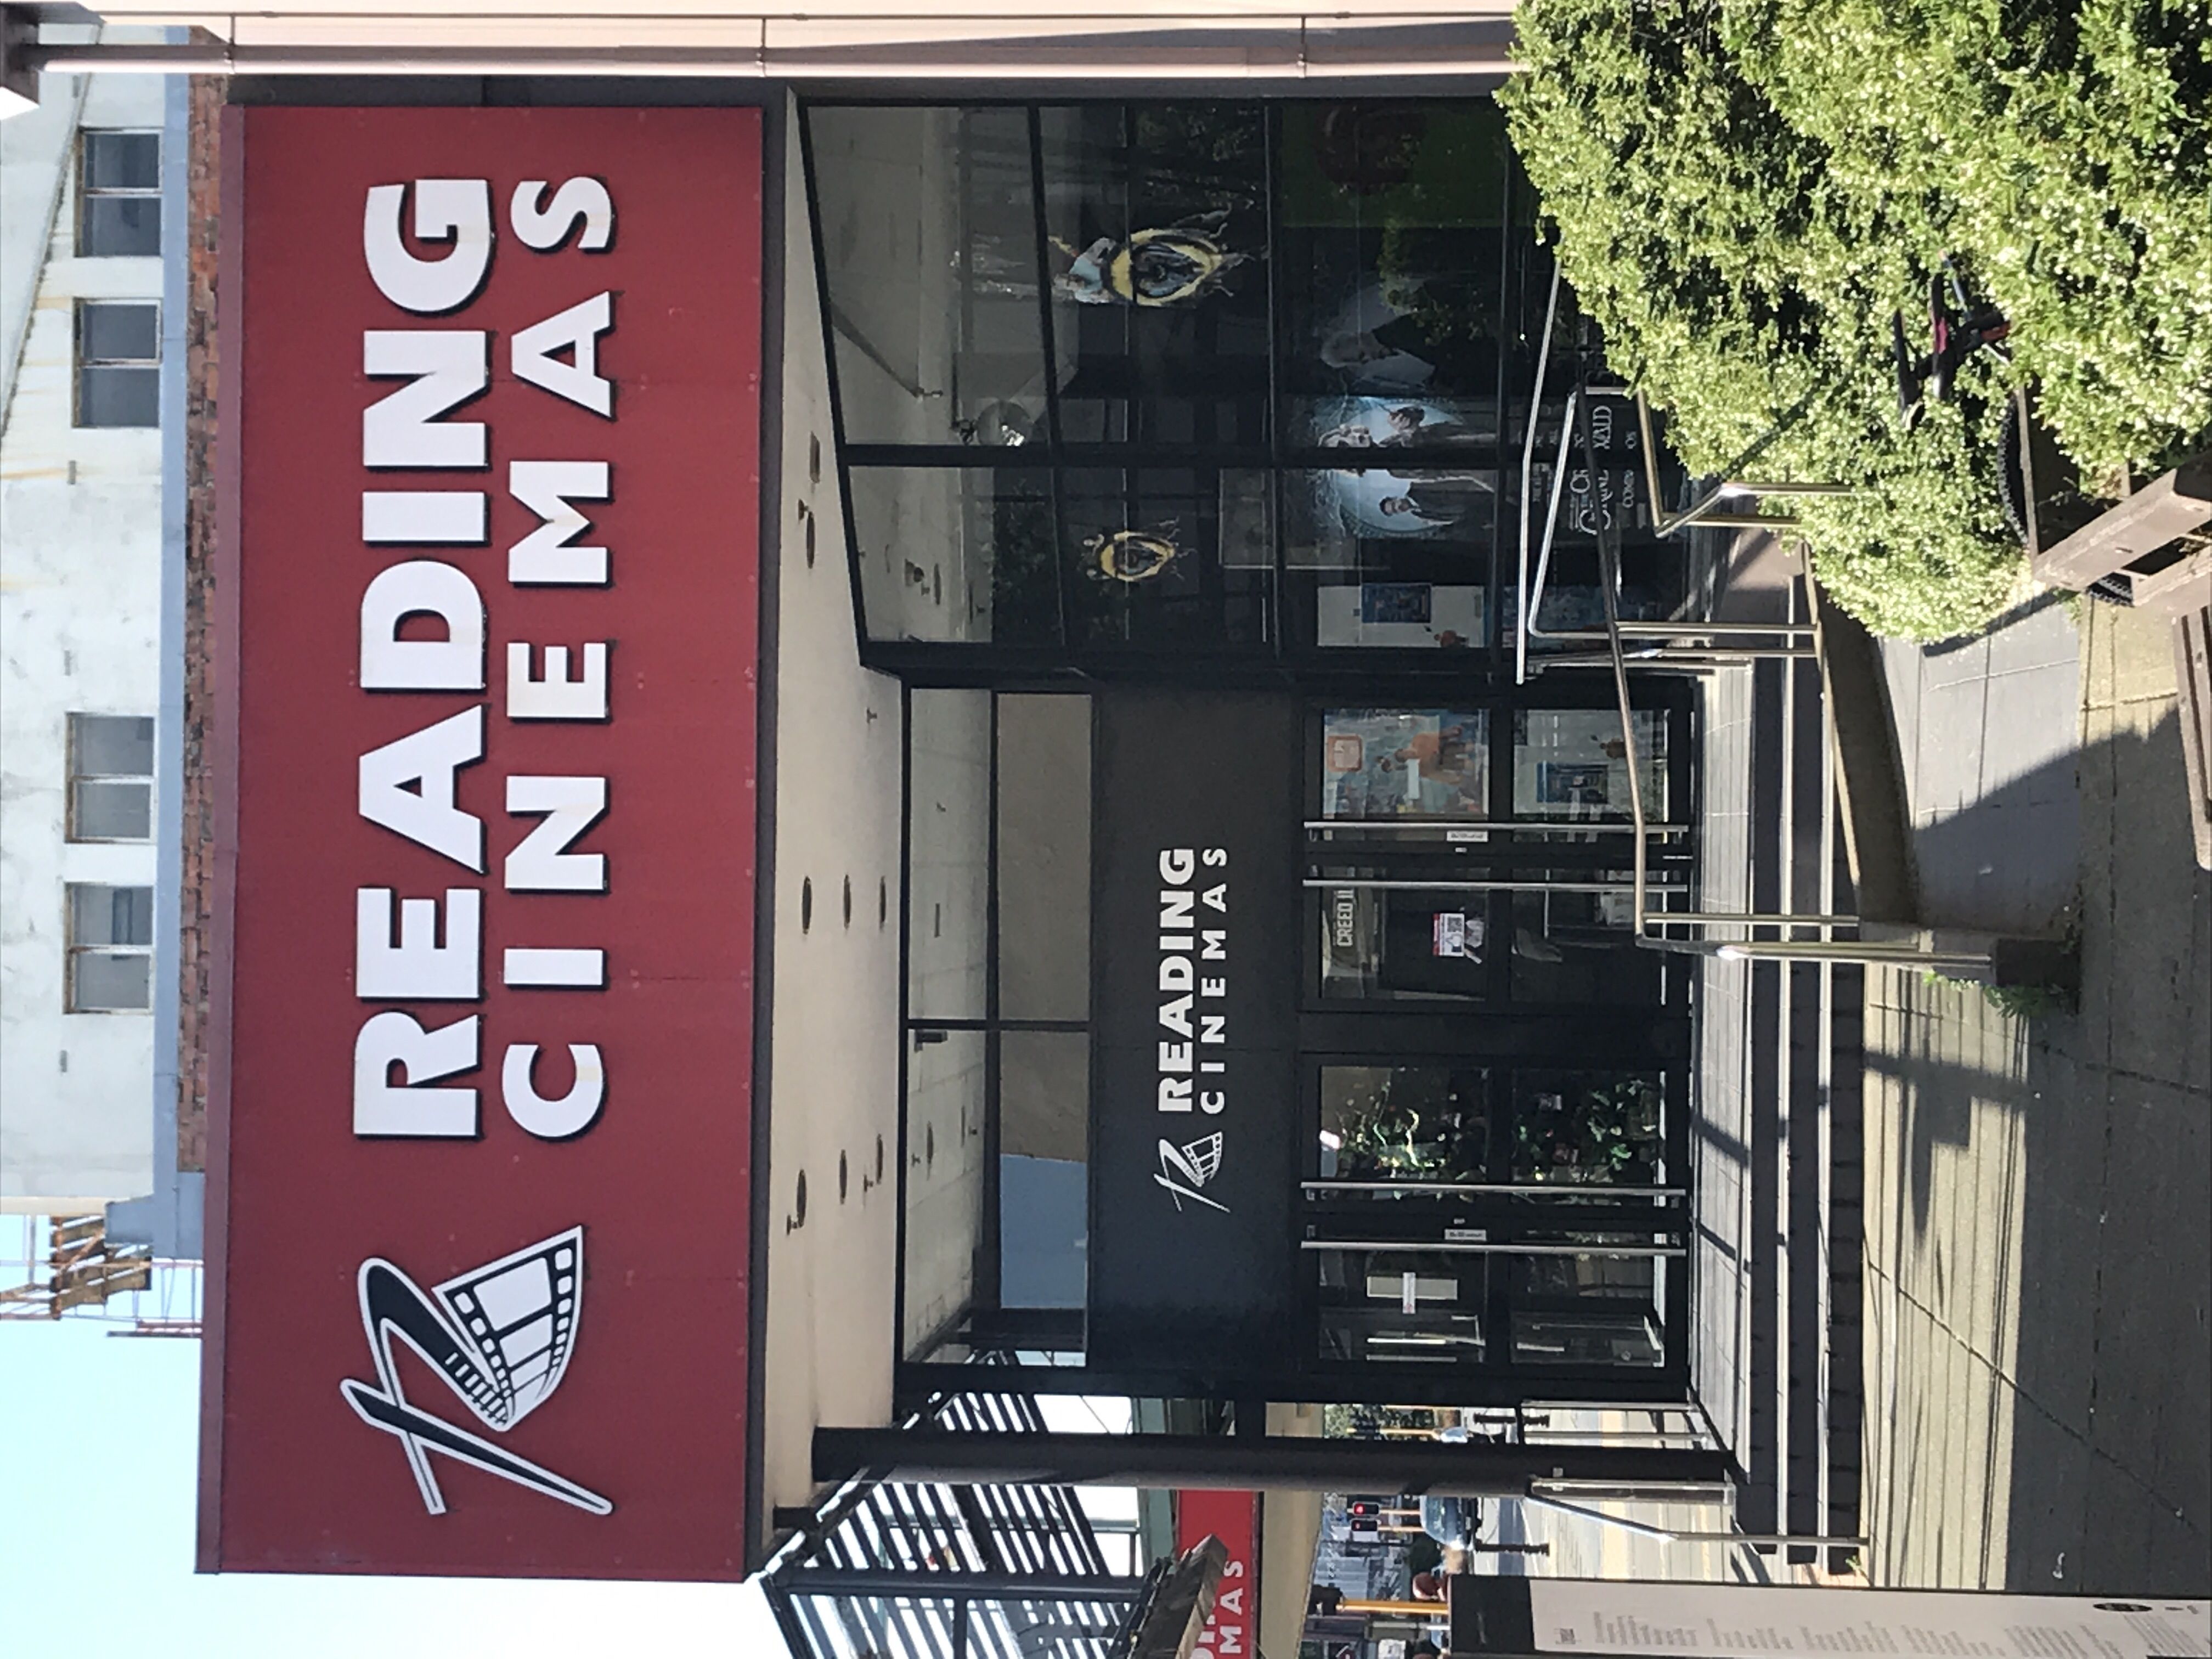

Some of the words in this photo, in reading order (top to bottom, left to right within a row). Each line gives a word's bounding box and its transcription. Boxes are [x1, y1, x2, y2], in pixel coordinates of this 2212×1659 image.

[352, 178, 492, 1137] READING
[501, 176, 614, 1138] CINEMAS
[1158, 848, 1195, 1113] READING
[1200, 848, 1228, 1115] CINEMAS
[1336, 902, 1354, 947] CREED
